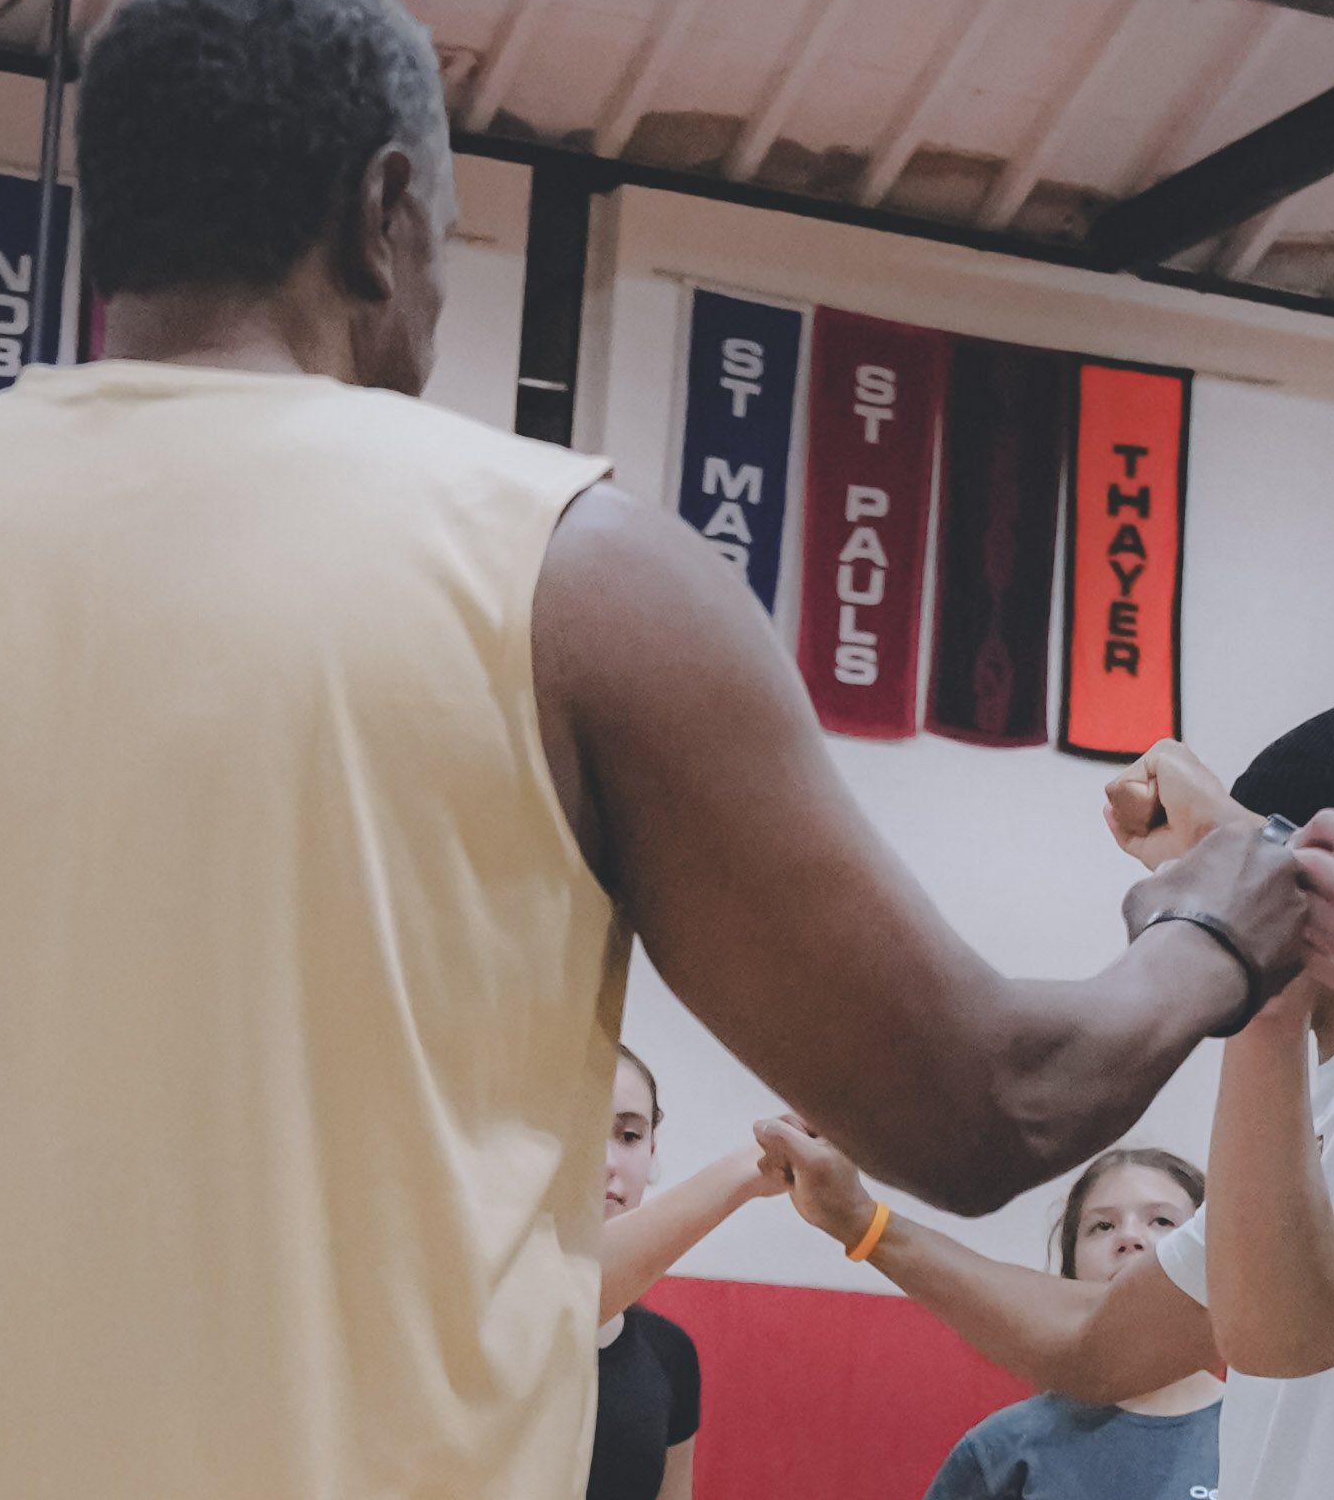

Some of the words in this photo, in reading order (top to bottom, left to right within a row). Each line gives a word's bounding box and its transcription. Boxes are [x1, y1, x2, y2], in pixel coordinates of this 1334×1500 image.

[720, 337, 764, 418] ST
[853, 364, 897, 444] ST
[835, 484, 890, 686] PAULS
[1104, 444, 1150, 676] THAYER
